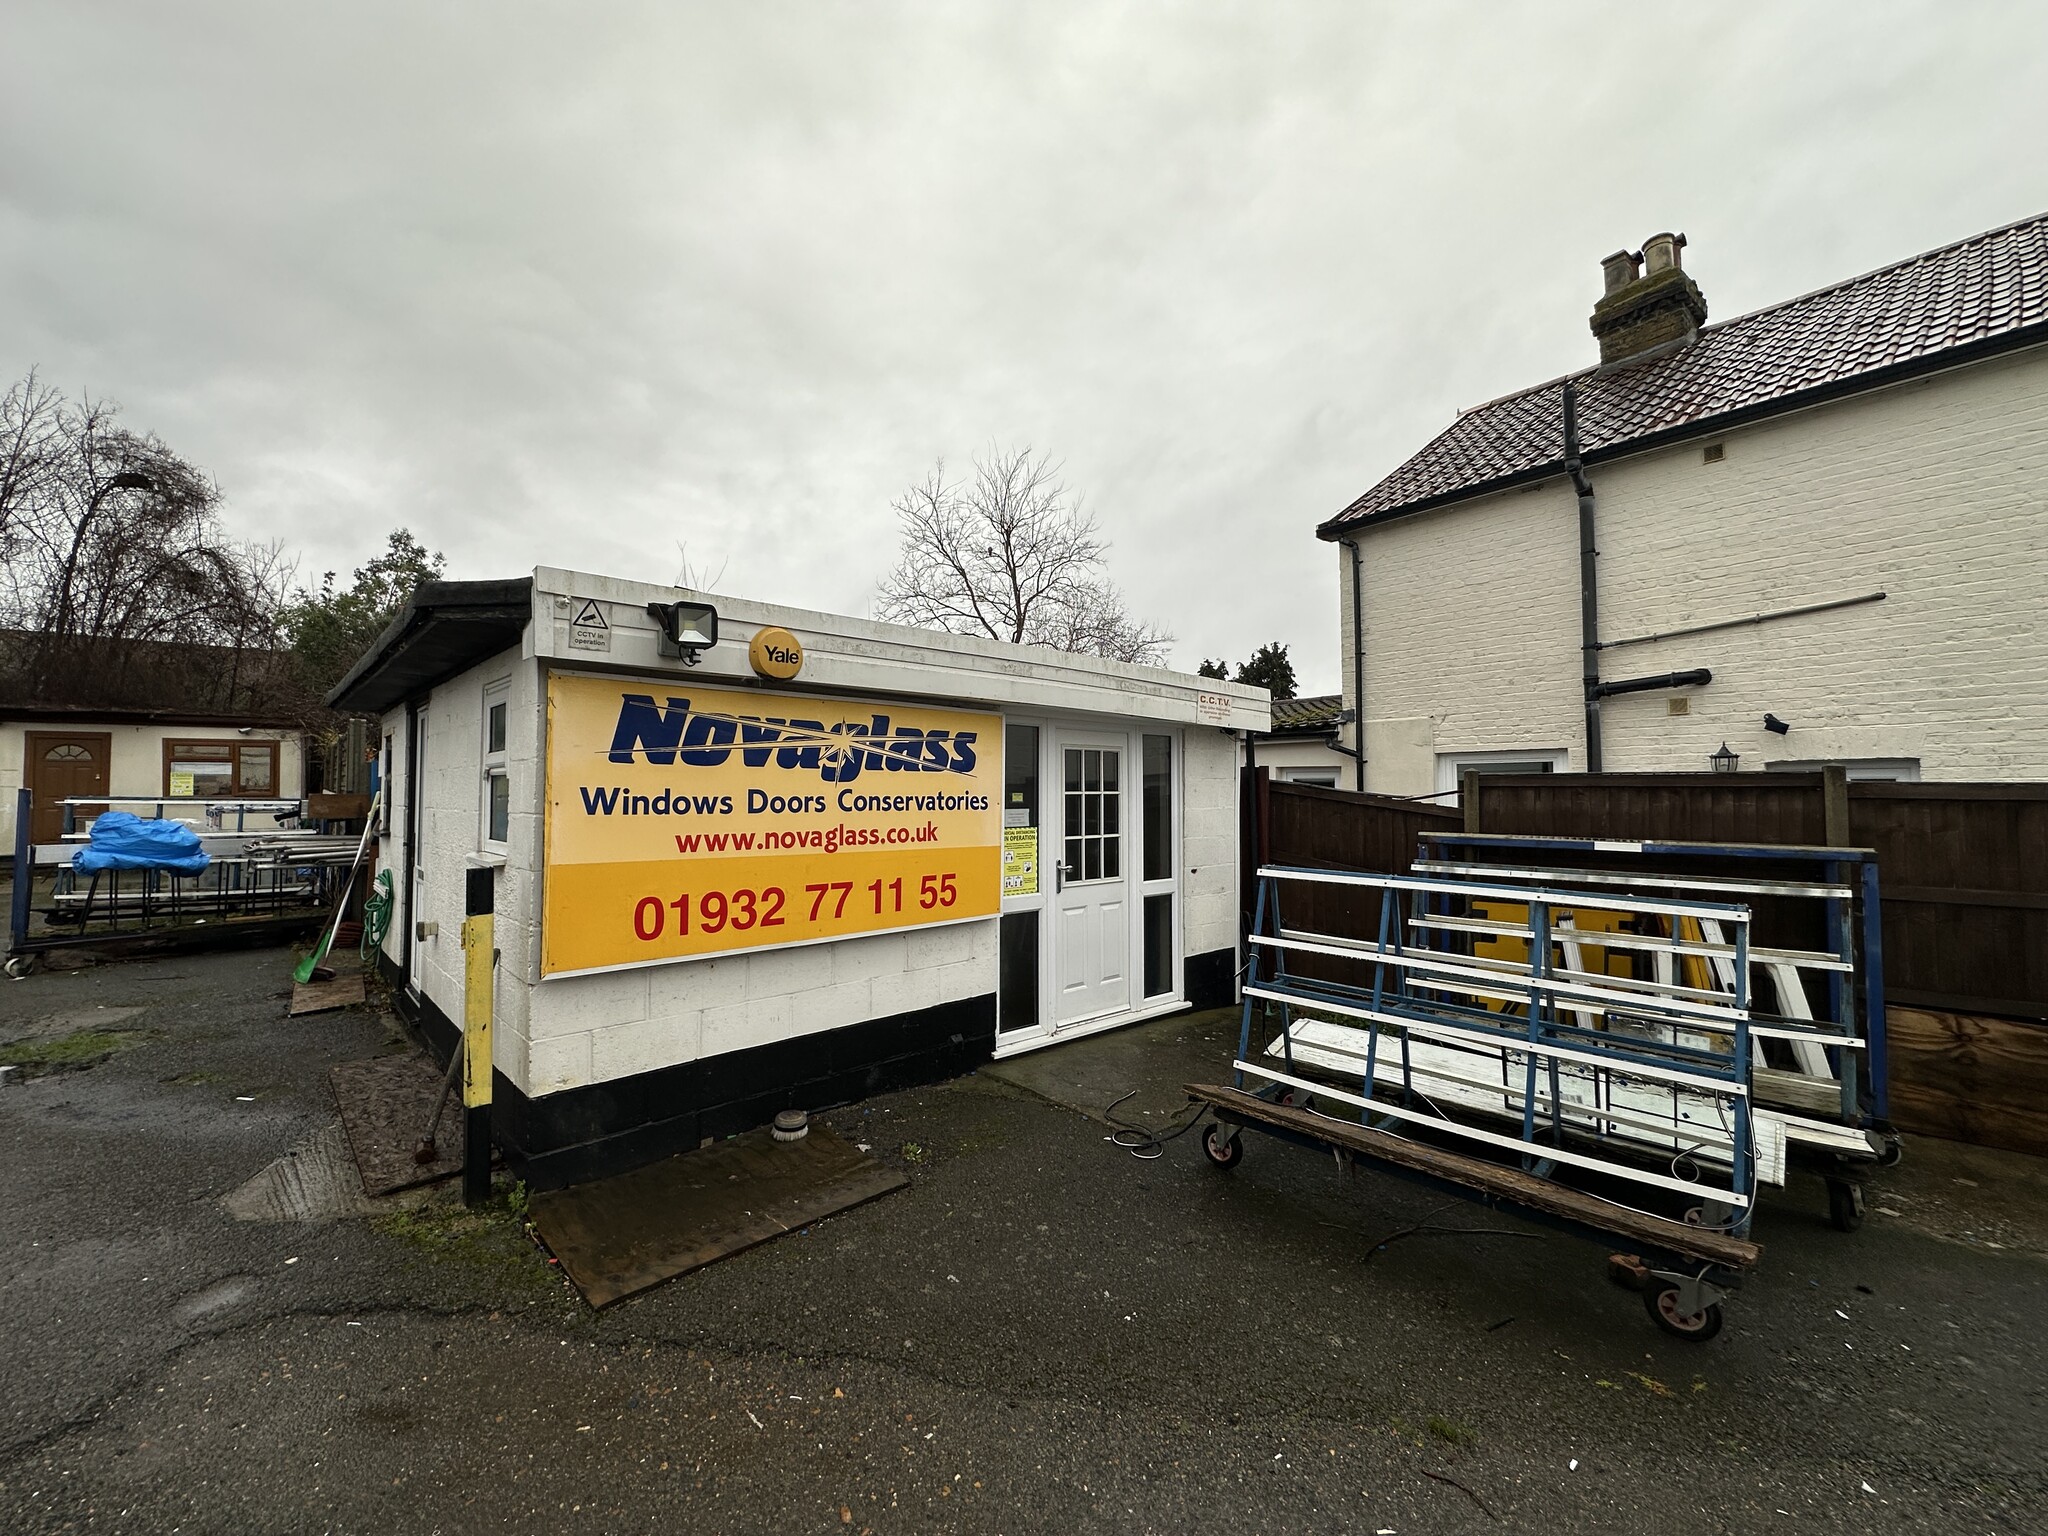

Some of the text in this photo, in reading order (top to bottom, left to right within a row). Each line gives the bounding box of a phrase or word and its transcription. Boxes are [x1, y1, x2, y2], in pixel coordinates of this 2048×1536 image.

[574, 638, 606, 646] operation
[577, 630, 597, 638] CCTV
[764, 644, 799, 665] Yale
[1200, 695, 1231, 707] C.C.T.V.
[608, 693, 978, 783] Novaglass
[579, 787, 989, 815] Windows Doors Conservatories
[675, 821, 939, 854] www.novaglass.co.uk
[634, 873, 958, 941] 01932 77 11 55
